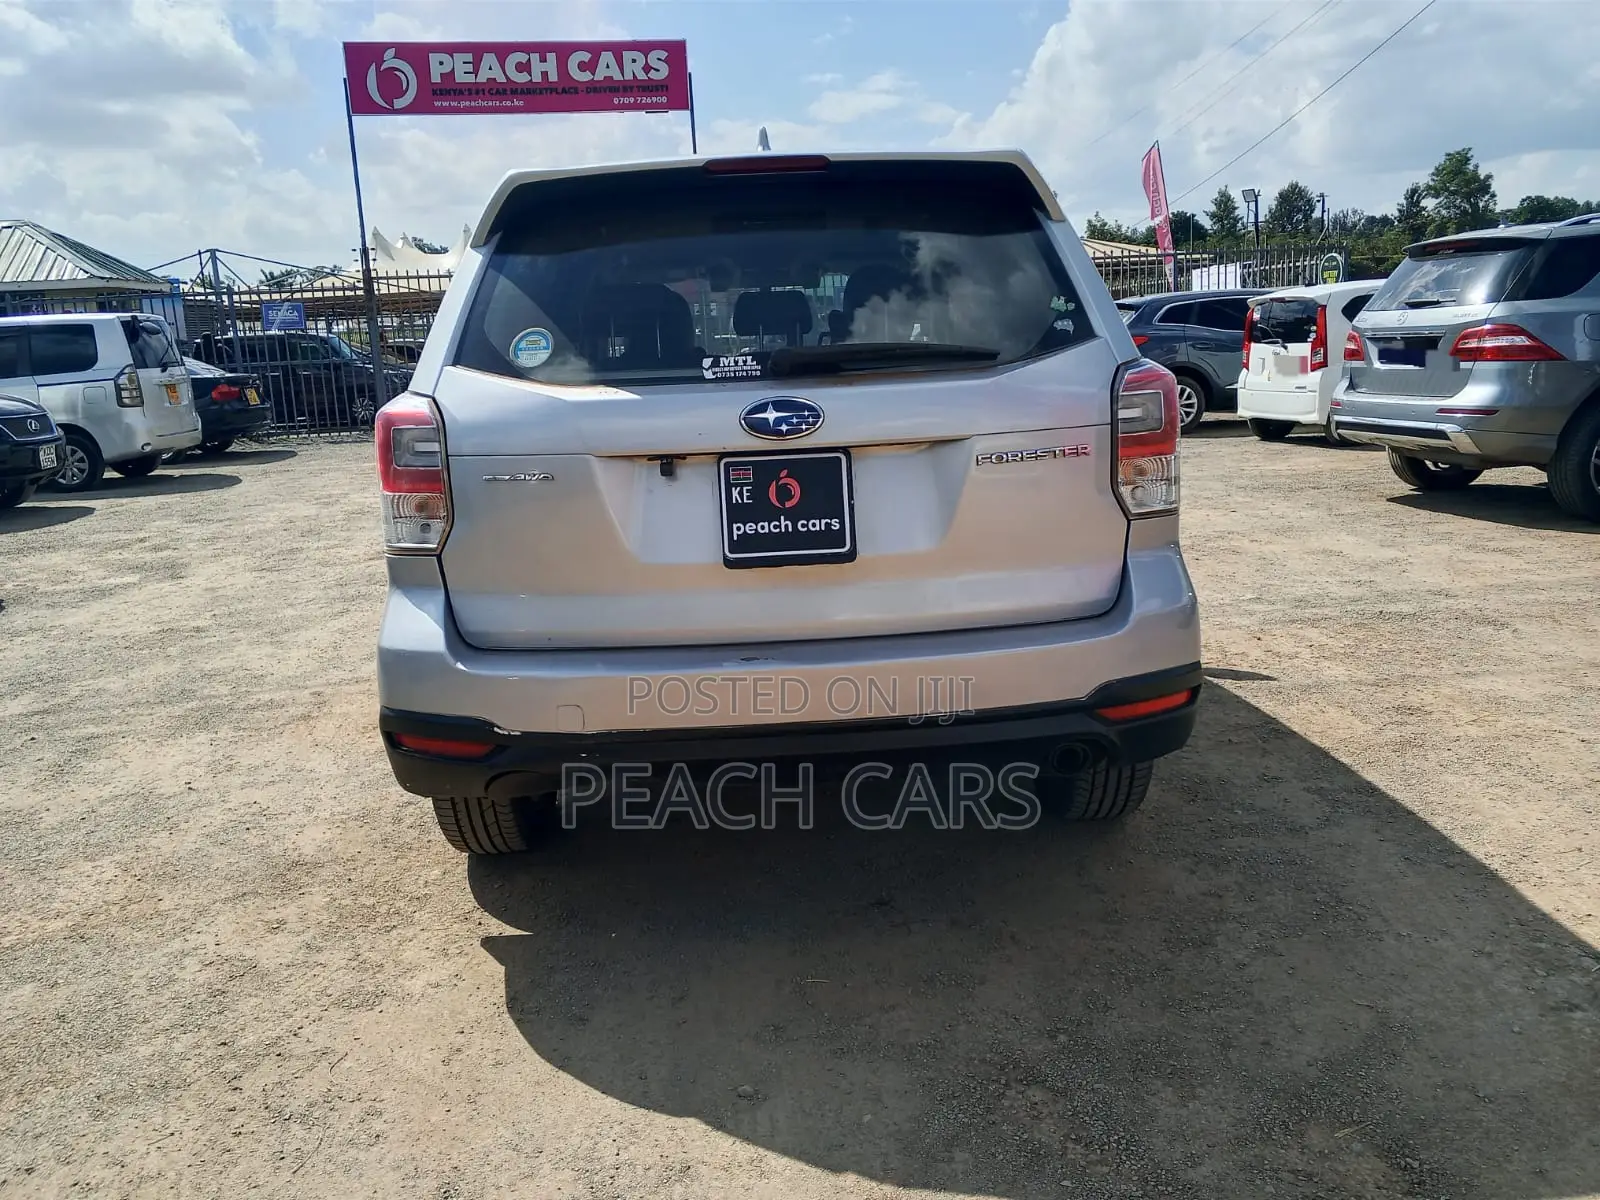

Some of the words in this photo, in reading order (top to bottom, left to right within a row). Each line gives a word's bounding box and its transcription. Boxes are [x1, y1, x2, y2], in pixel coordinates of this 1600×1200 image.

[428, 52, 559, 83] PEACH
[567, 49, 670, 82] CARS
[431, 86, 473, 96] KENYA'S
[487, 86, 508, 96] CAR
[510, 85, 580, 96] MARKETPLACE
[586, 84, 620, 94] DRIVEN
[622, 84, 634, 93] BY
[433, 98, 525, 108] www.peachcars.co.ke
[613, 96, 634, 104] 0709
[636, 95, 668, 104] 726900
[719, 355, 757, 366] MTL
[975, 443, 1092, 466] FORESTER
[731, 486, 753, 504] KE
[732, 515, 793, 540] peach
[797, 518, 840, 532] cars
